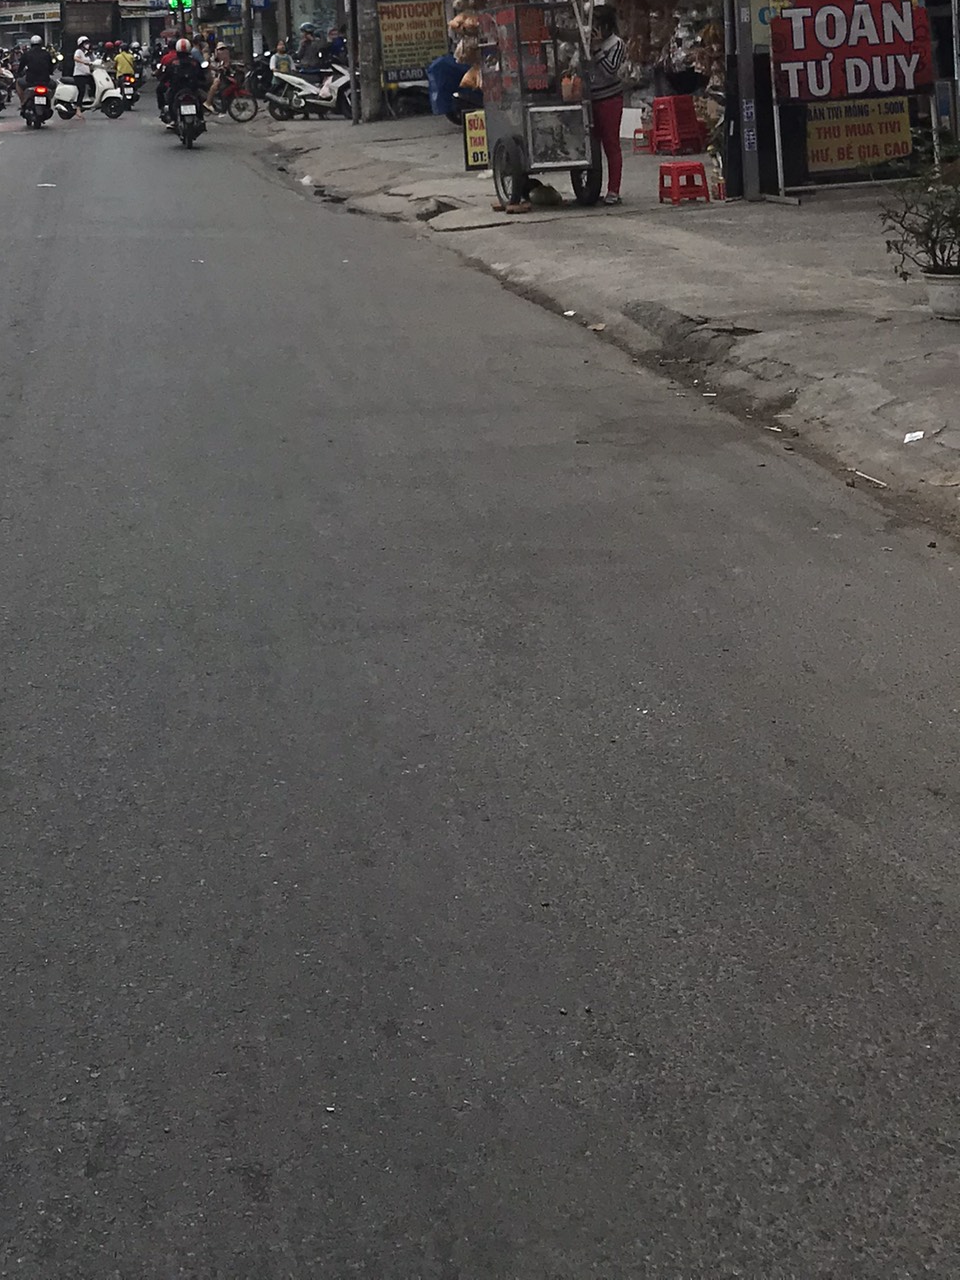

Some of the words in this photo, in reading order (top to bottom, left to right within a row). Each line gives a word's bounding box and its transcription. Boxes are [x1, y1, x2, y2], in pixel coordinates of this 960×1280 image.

[380, 1, 442, 20] PHOTOCOPY
[400, 69, 424, 79] CARD
[781, 52, 834, 98] TƯ
[845, 53, 920, 95] DUY
[815, 124, 841, 139] THU
[845, 122, 874, 137] MUA
[877, 120, 901, 135] TIVI
[883, 140, 909, 156] CAO
